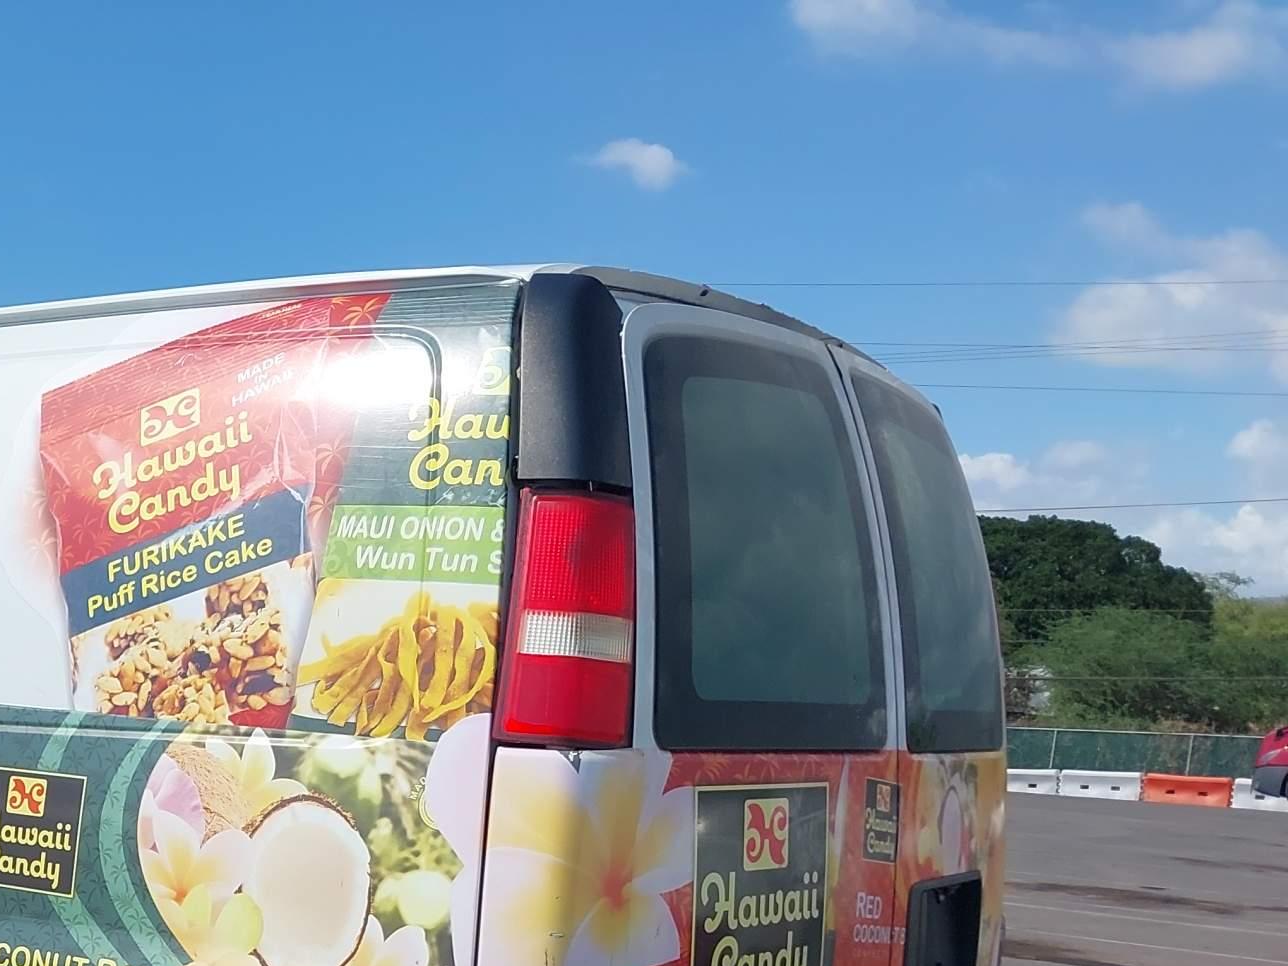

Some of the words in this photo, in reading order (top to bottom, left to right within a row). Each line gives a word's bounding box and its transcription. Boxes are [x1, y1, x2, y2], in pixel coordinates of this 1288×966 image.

[237, 352, 286, 384] MADE
[92, 411, 253, 500] Hawaii
[107, 461, 242, 534] Candy
[336, 514, 395, 539] MAUI
[400, 515, 485, 541] ONION
[87, 580, 137, 618] Puff
[140, 563, 198, 598] Rice
[204, 537, 273, 575] Cake
[107, 513, 246, 583] FURIKAKE
[355, 545, 415, 571] Wun
[425, 547, 478, 573] Tun
[701, 871, 819, 934] Hawaii
[855, 892, 882, 919] RED
